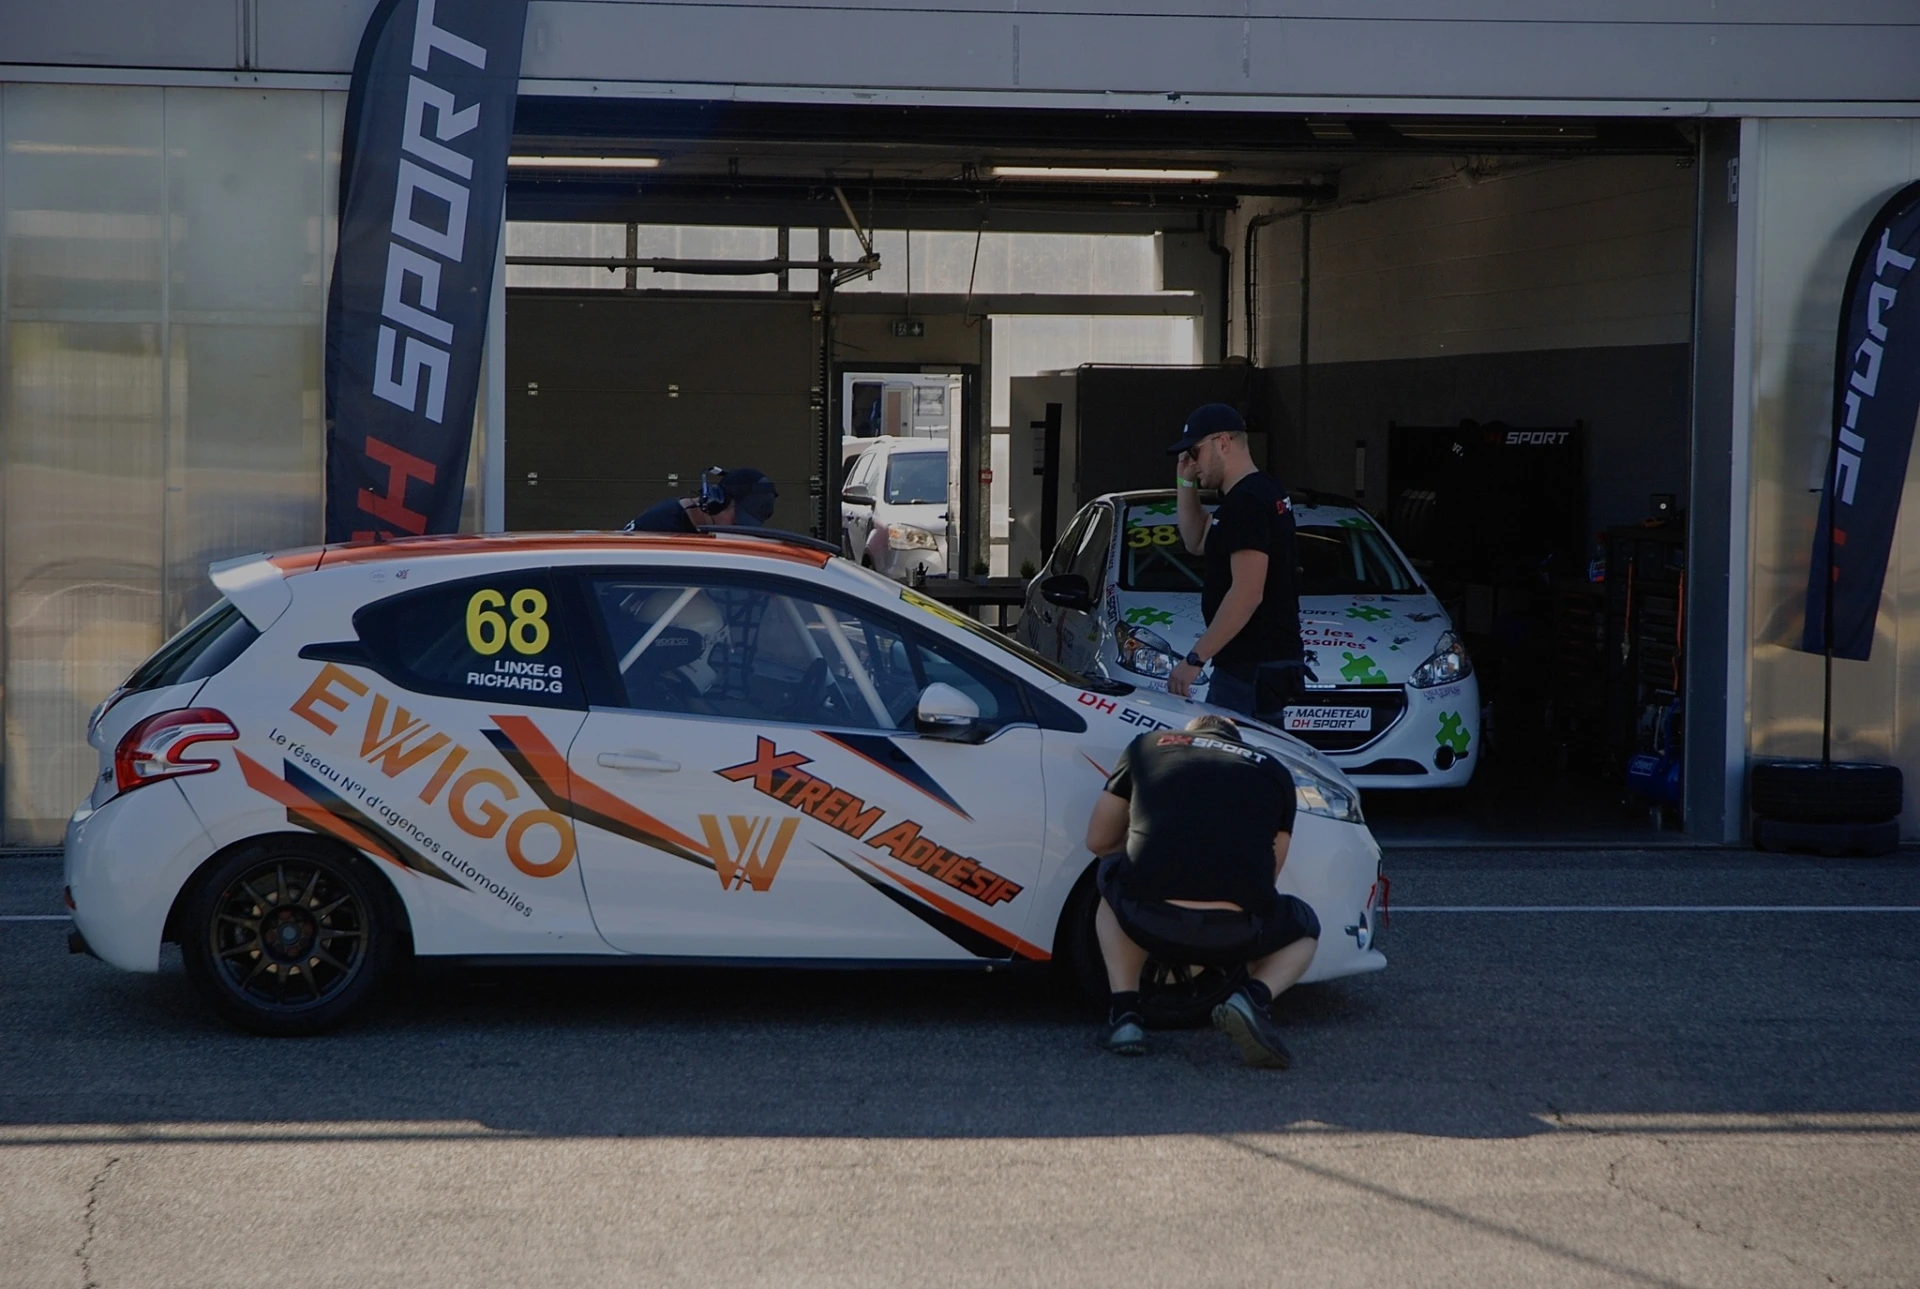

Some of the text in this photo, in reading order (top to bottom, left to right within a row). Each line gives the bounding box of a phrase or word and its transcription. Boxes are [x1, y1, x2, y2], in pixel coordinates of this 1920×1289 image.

[351, 0, 488, 543] H SPORT
[1505, 431, 1570, 445] SPORT
[1126, 525, 1178, 549] 38
[465, 588, 551, 656] 68
[1106, 597, 1119, 625] SPORT
[1298, 609, 1340, 618] ORT
[1323, 628, 1354, 639] les
[494, 659, 563, 679] LINXE.G
[466, 671, 564, 694] RICHARD.G
[1077, 692, 1118, 715] DH
[1295, 708, 1370, 719] MACHETEAU
[1291, 719, 1356, 729] DH SPORT
[1156, 734, 1268, 764] DH SPORT
[289, 661, 577, 878] EWIGO
[268, 727, 287, 746] Le
[287, 744, 341, 783] réseau
[366, 795, 441, 854] d'agences
[441, 850, 534, 918] automobiles
